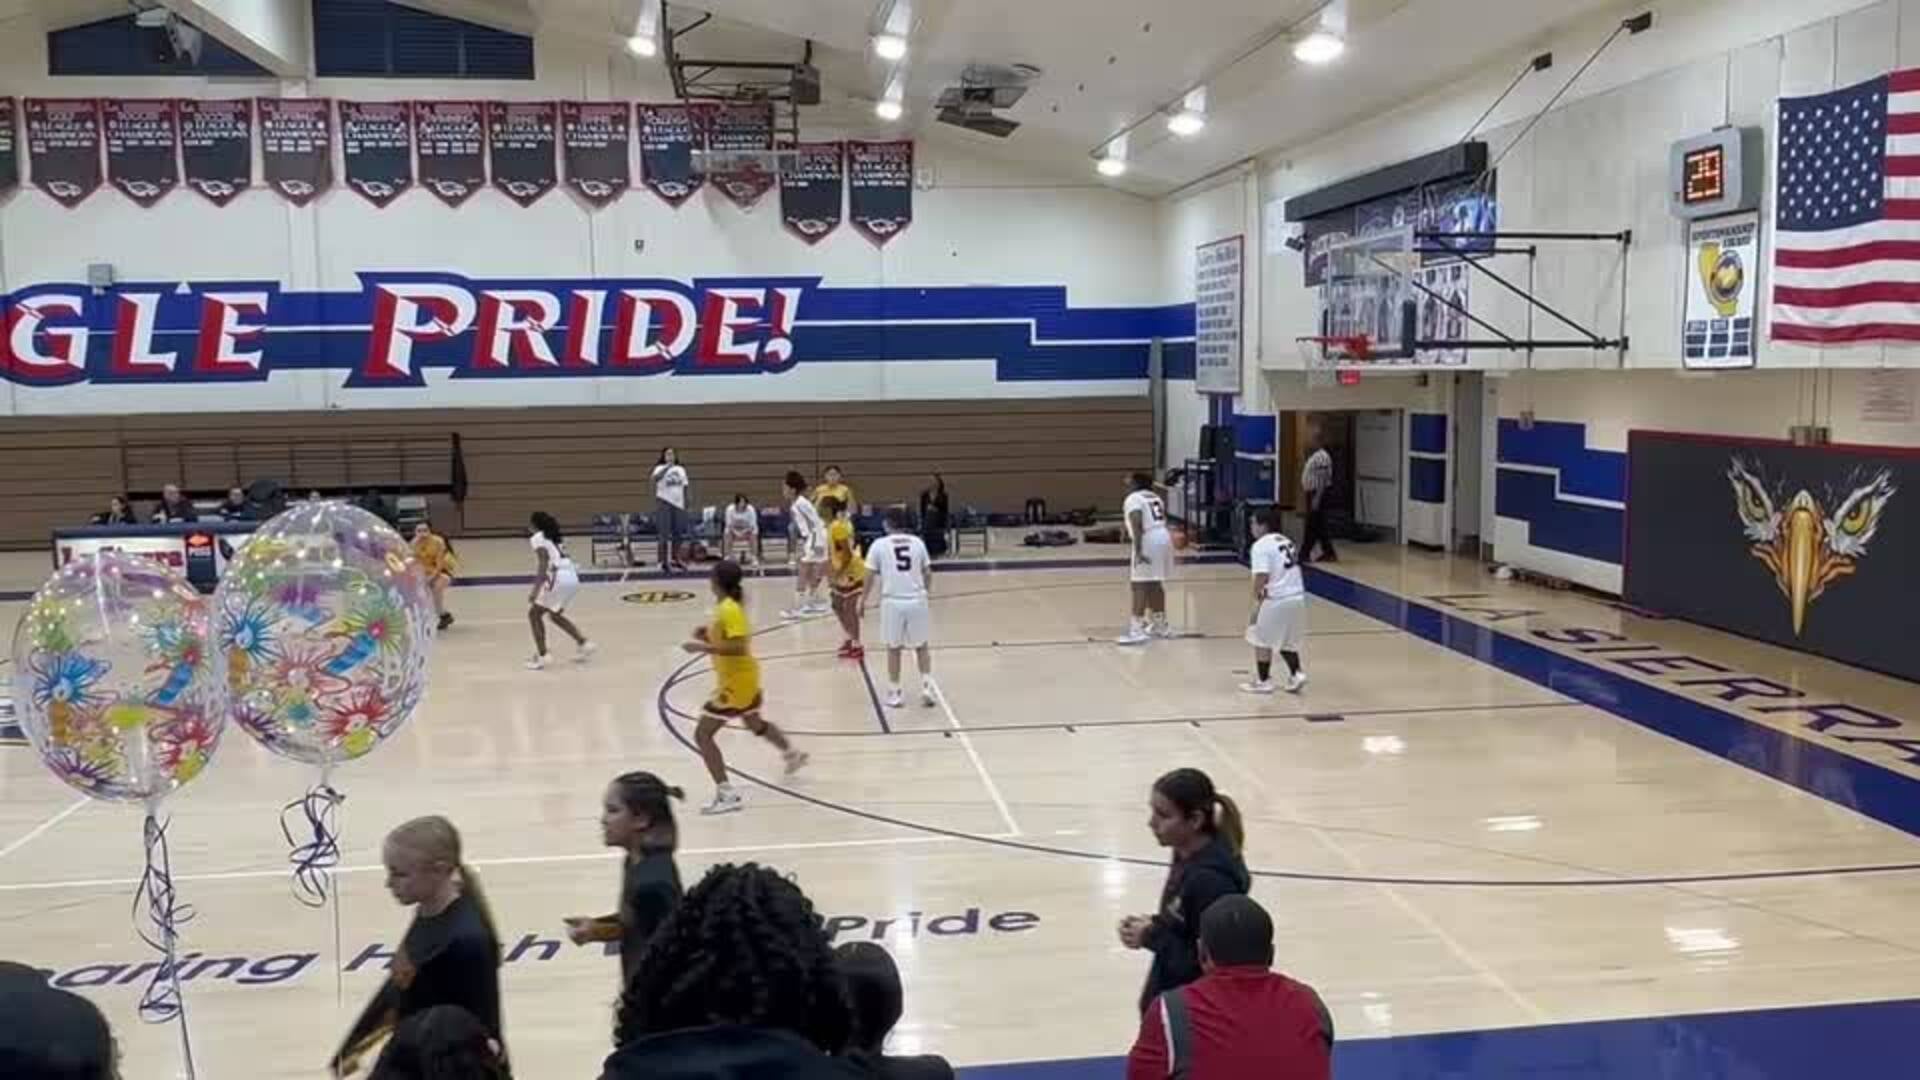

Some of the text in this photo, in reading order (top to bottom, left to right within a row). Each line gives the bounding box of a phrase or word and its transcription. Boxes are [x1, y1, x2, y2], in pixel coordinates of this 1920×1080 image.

[1687, 150, 1720, 199] 29
[364, 283, 803, 379] PRIDE!
[894, 546, 912, 572] 5
[1425, 593, 1920, 765] LA SIERRA
